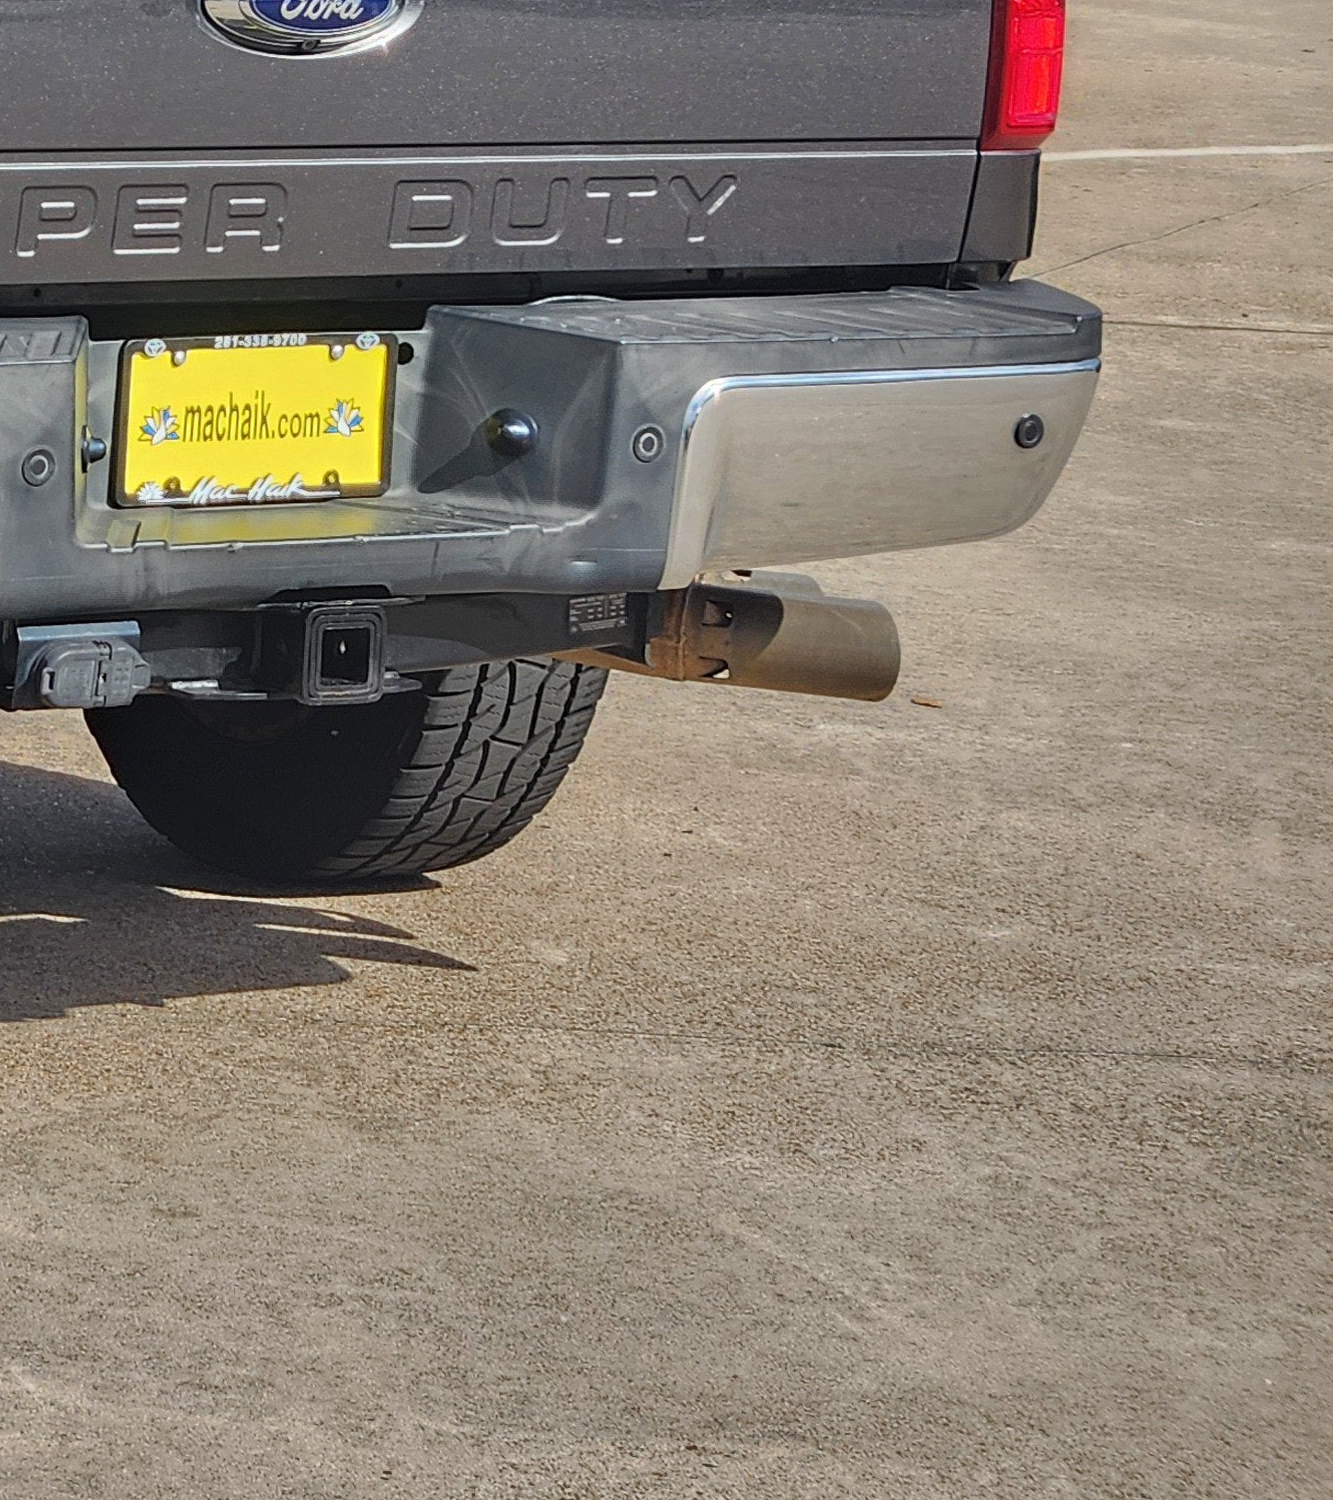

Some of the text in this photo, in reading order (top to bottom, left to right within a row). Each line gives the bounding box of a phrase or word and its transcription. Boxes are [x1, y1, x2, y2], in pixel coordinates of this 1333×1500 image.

[388, 175, 737, 249] DUTY
[182, 390, 321, 443] machaik.com
[188, 472, 308, 506] Mac Haik
